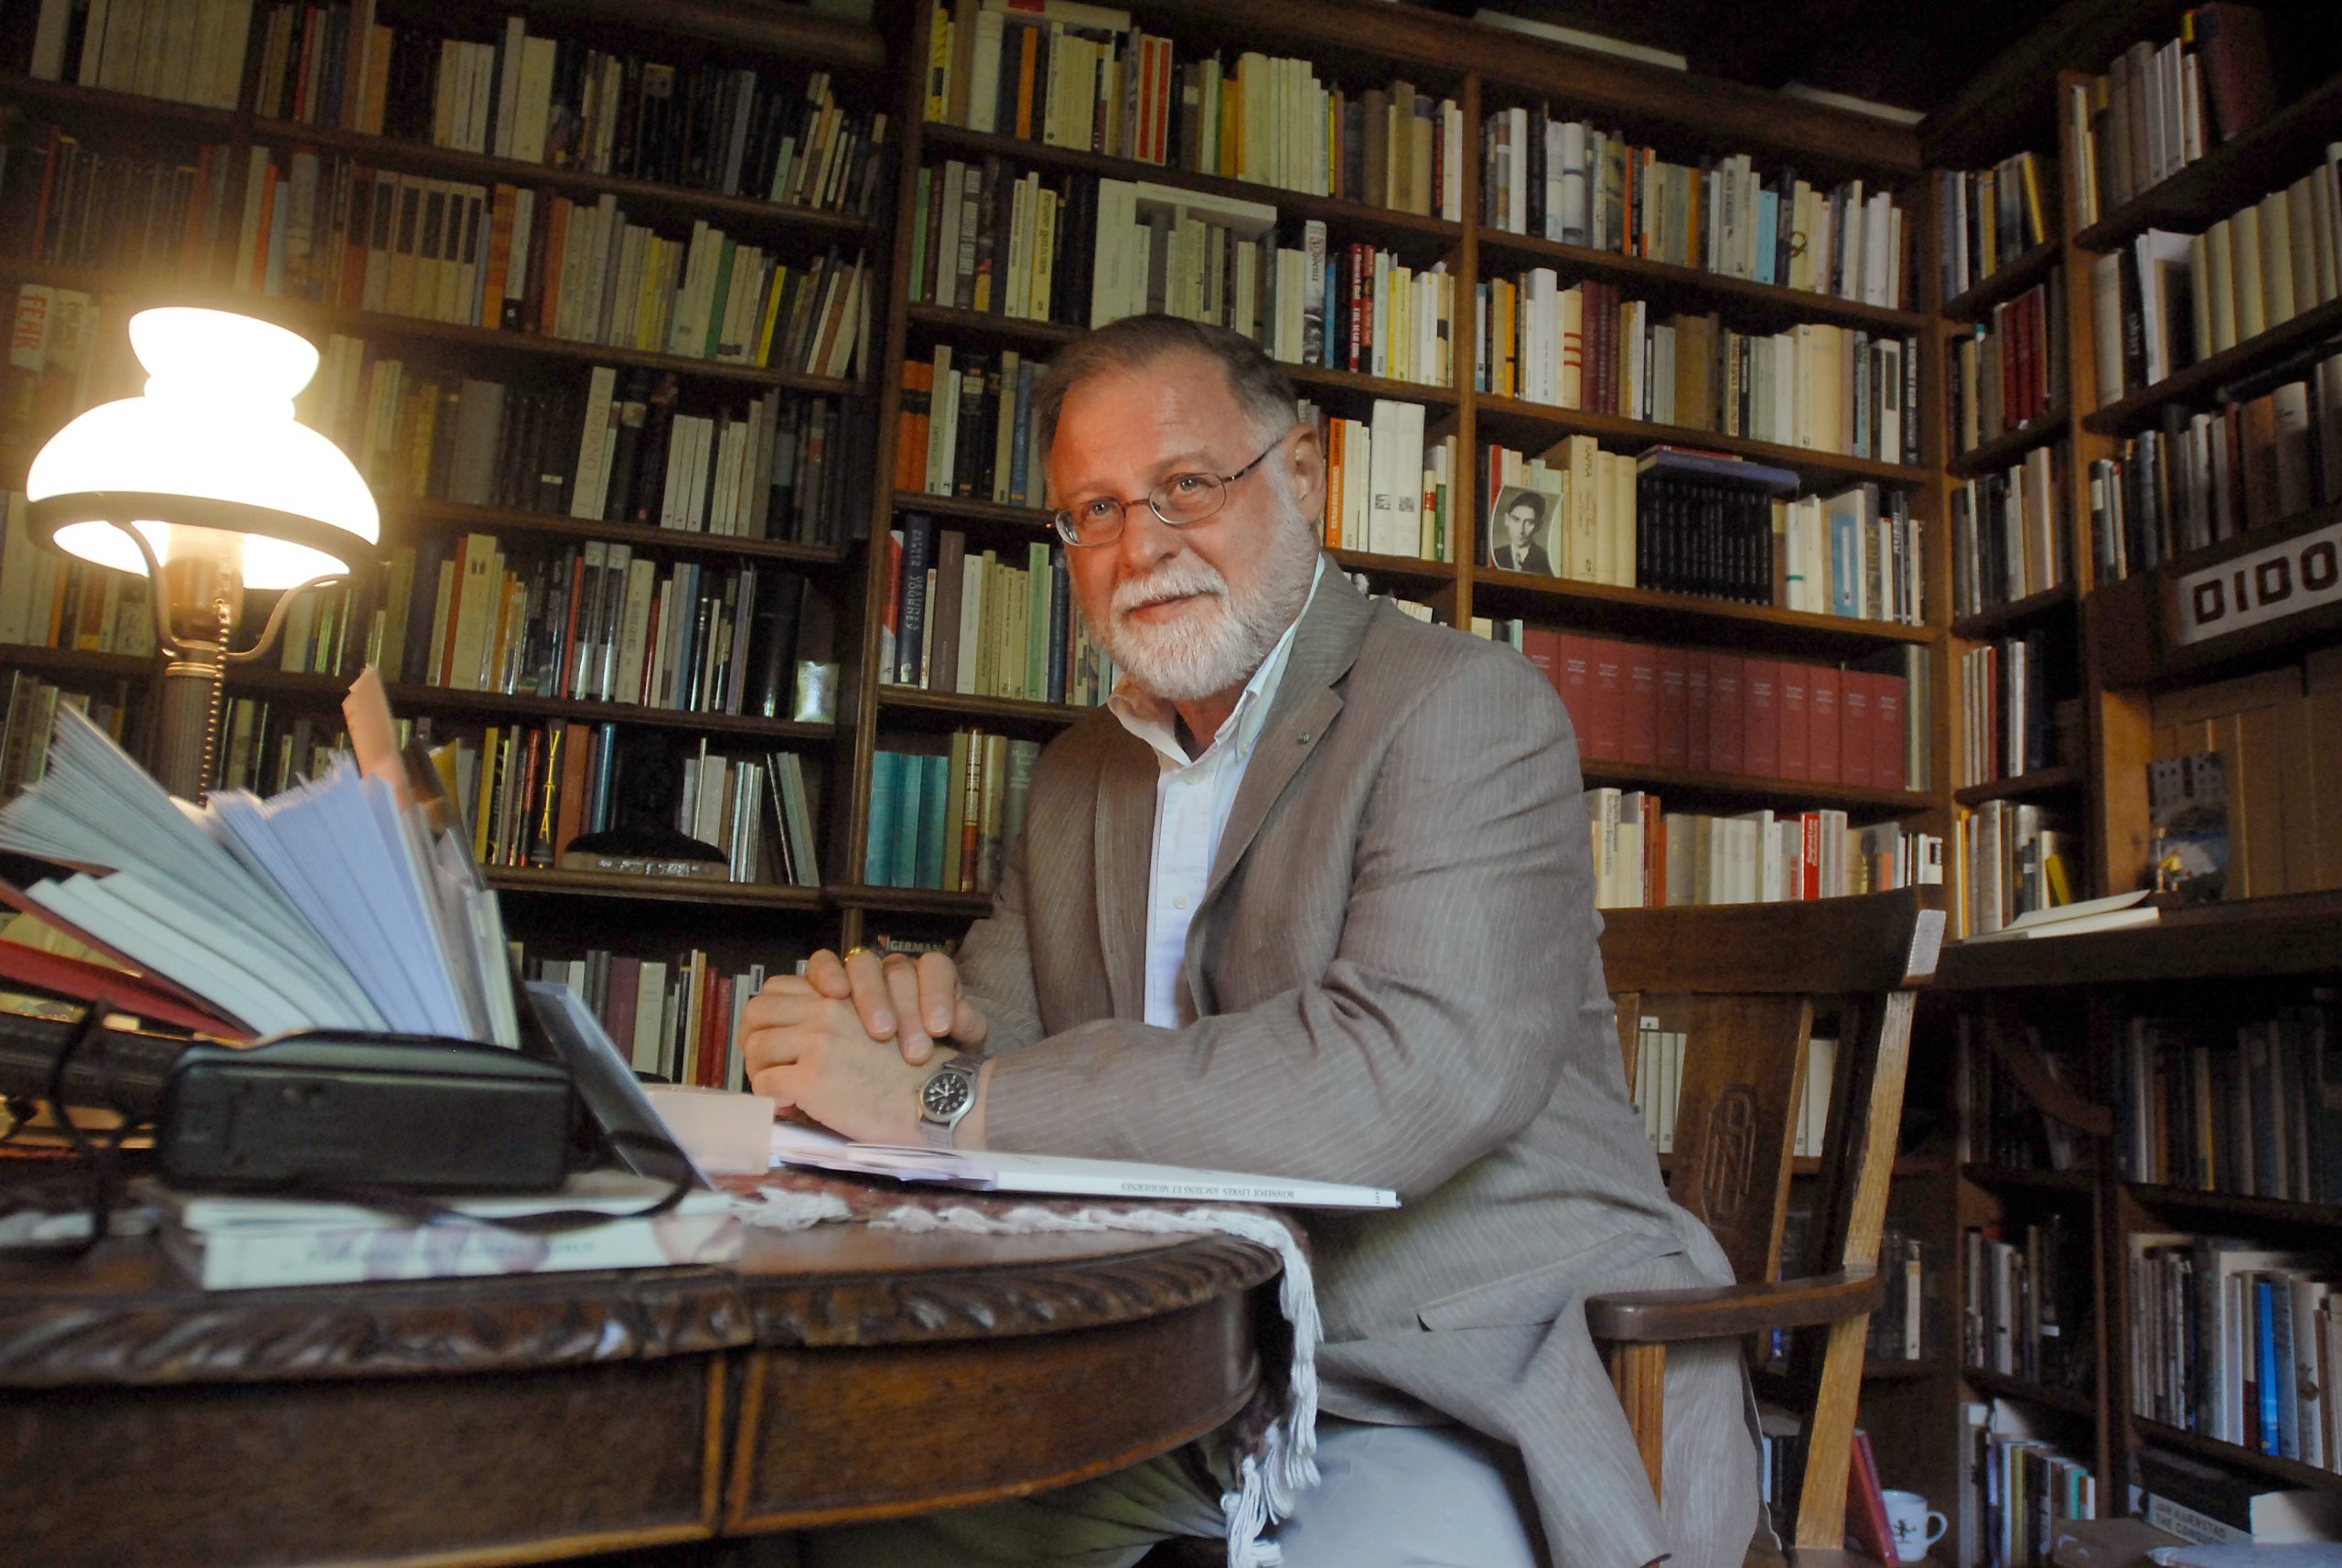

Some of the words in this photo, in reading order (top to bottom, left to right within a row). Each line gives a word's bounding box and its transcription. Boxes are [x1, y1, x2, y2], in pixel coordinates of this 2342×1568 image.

[585, 405, 606, 471] INFERNO
[1585, 445, 1594, 478] KAFKA
[2194, 535, 2342, 625] DIDO
[906, 575, 916, 630] JOURNEY
[1121, 1183, 1170, 1193] MODERNES
[1172, 1186, 1183, 1194] ET
[1184, 1187, 1219, 1196] ANCIENS
[1223, 1188, 1251, 1197] LIVRES
